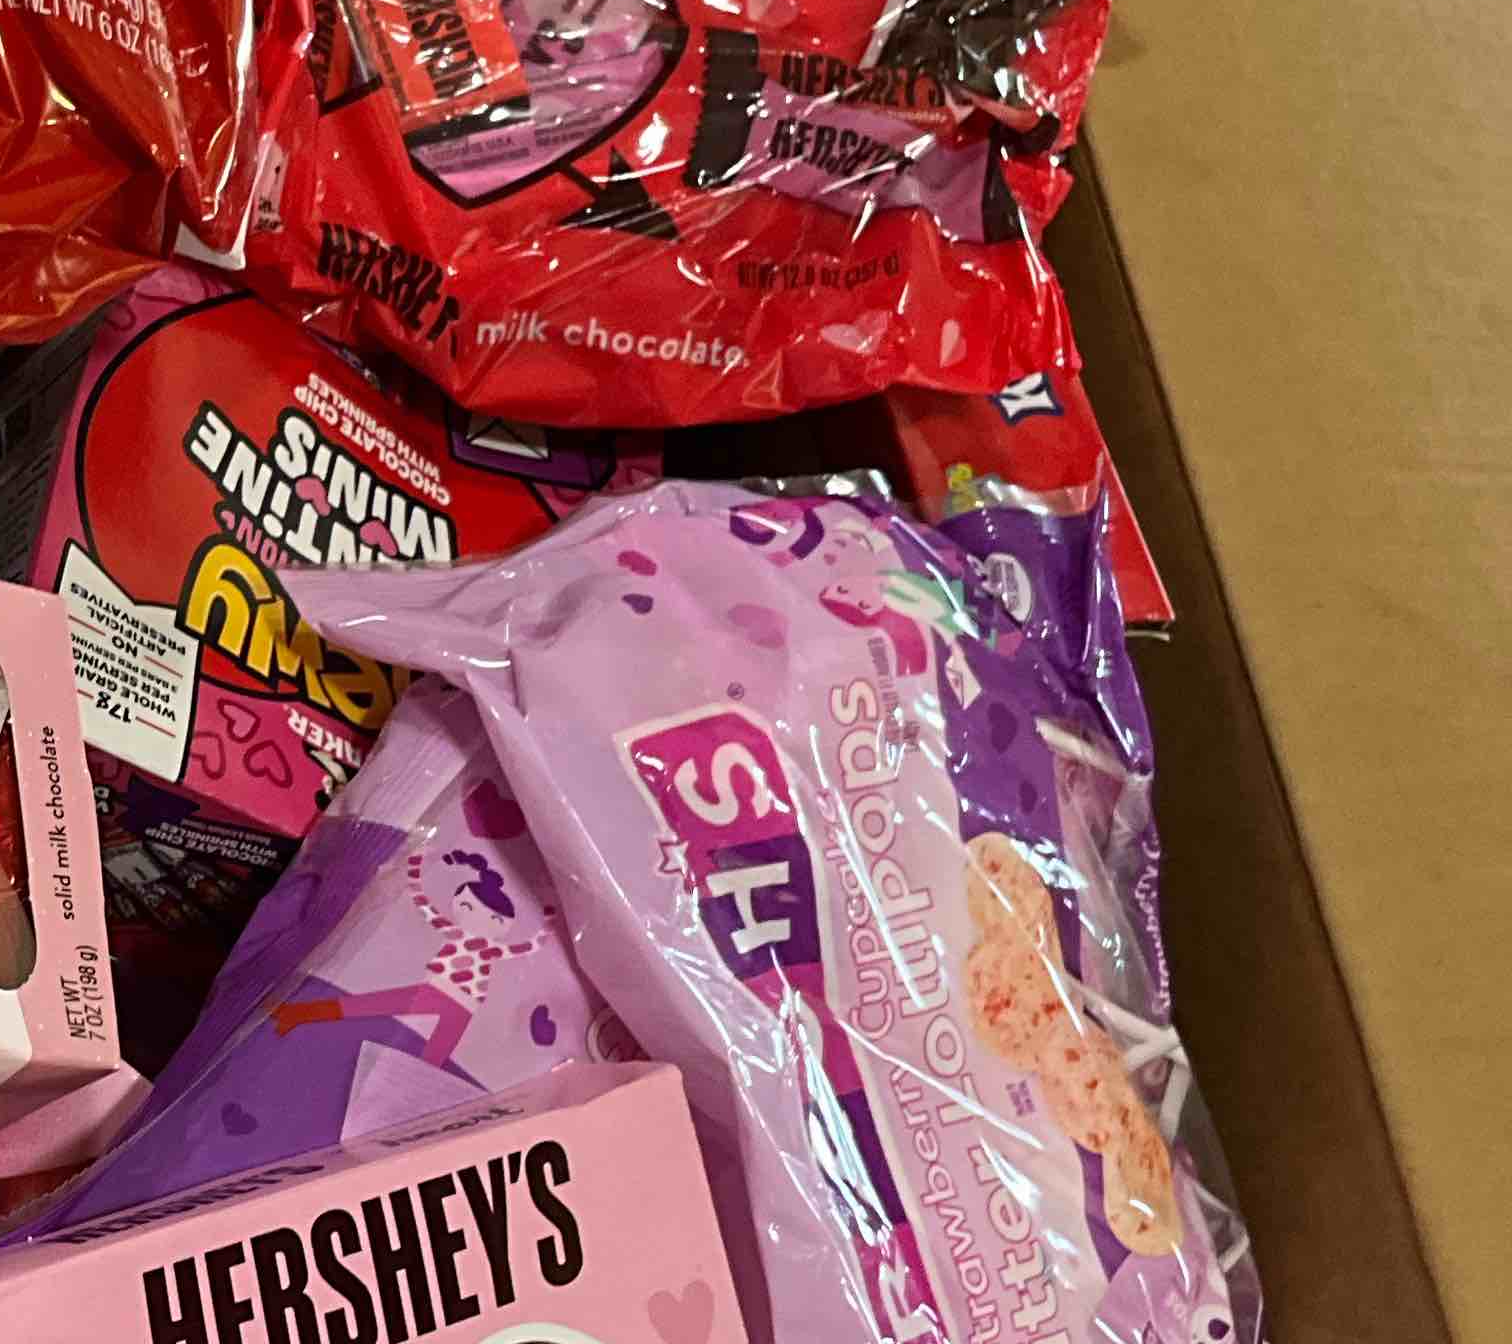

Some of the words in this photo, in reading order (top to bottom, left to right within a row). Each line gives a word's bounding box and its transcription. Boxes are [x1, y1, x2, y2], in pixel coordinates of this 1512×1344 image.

[99, 11, 113, 41] 6
[115, 17, 143, 55] OZ
[475, 311, 549, 348] milk
[561, 314, 751, 372] chocolate
[292, 384, 341, 428] CHIP
[308, 371, 398, 449] SPRINKLES
[339, 418, 452, 507] CHOCOLATE
[394, 441, 442, 483] WITH
[69, 581, 187, 656] PRESERVATIVES
[86, 605, 167, 657] ARTIFICIAL
[110, 634, 139, 658] NO
[117, 657, 140, 673] PER
[71, 647, 139, 687] SERVING
[140, 667, 170, 689] BARS
[95, 690, 133, 724] 17g
[120, 688, 177, 722] WHOLE
[140, 682, 171, 704] PER
[45, 726, 65, 821] chocolate
[48, 825, 70, 867] milk
[54, 873, 76, 921] solid
[75, 944, 99, 963] g)
[60, 975, 81, 1003] WT
[78, 964, 105, 1001] (198
[65, 1005, 88, 1040] NET
[84, 1004, 105, 1027] OZ
[87, 1030, 107, 1041] 7
